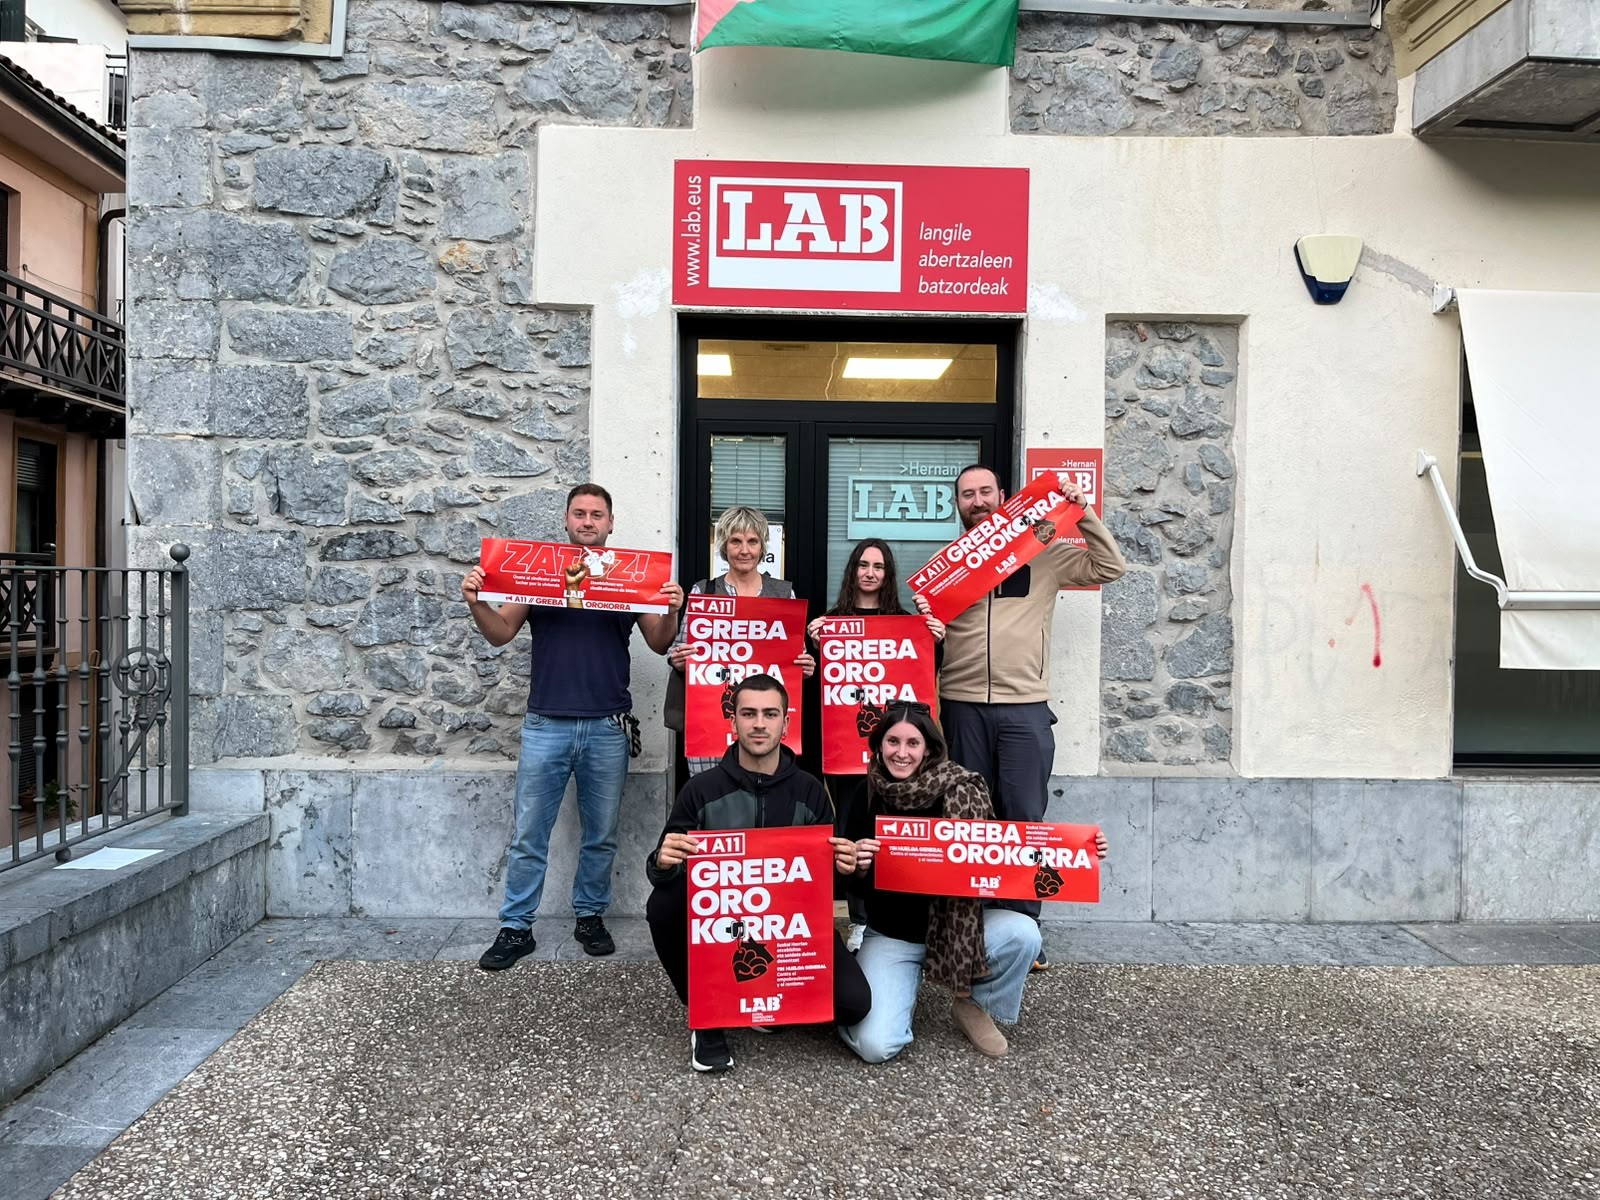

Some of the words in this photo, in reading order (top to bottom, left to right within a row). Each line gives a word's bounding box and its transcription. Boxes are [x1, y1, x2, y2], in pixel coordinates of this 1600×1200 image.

[681, 175, 702, 287] www.lab.eus
[722, 190, 889, 254] LAB
[918, 222, 972, 246] langile
[918, 250, 1013, 269] abertzaleen
[918, 276, 1009, 296] batzordeak
[854, 483, 954, 520] LAB
[946, 513, 1009, 562] GREBA
[965, 490, 1066, 569] OROKORRA
[926, 560, 946, 580] A11
[995, 553, 1018, 574] LAB
[514, 595, 527, 603] A11
[535, 597, 564, 606] GREBA
[563, 589, 585, 599] LAB
[585, 601, 631, 611] OROKORRA
[707, 599, 731, 614] A11
[689, 618, 788, 641] GREBA
[839, 622, 862, 634] A11
[689, 641, 754, 662] ORO
[823, 639, 918, 660] GREBA
[823, 661, 886, 683] ORO
[823, 683, 918, 706] KORRA
[900, 823, 925, 837] A11
[934, 820, 1021, 844] GREBA
[711, 836, 740, 853] A11
[947, 843, 1092, 870] OROKORRA
[691, 856, 813, 888] GREBA
[970, 876, 1000, 889] LAB
[691, 886, 771, 916] ORO
[691, 913, 812, 945] KORRA
[740, 995, 781, 1014] LAB
